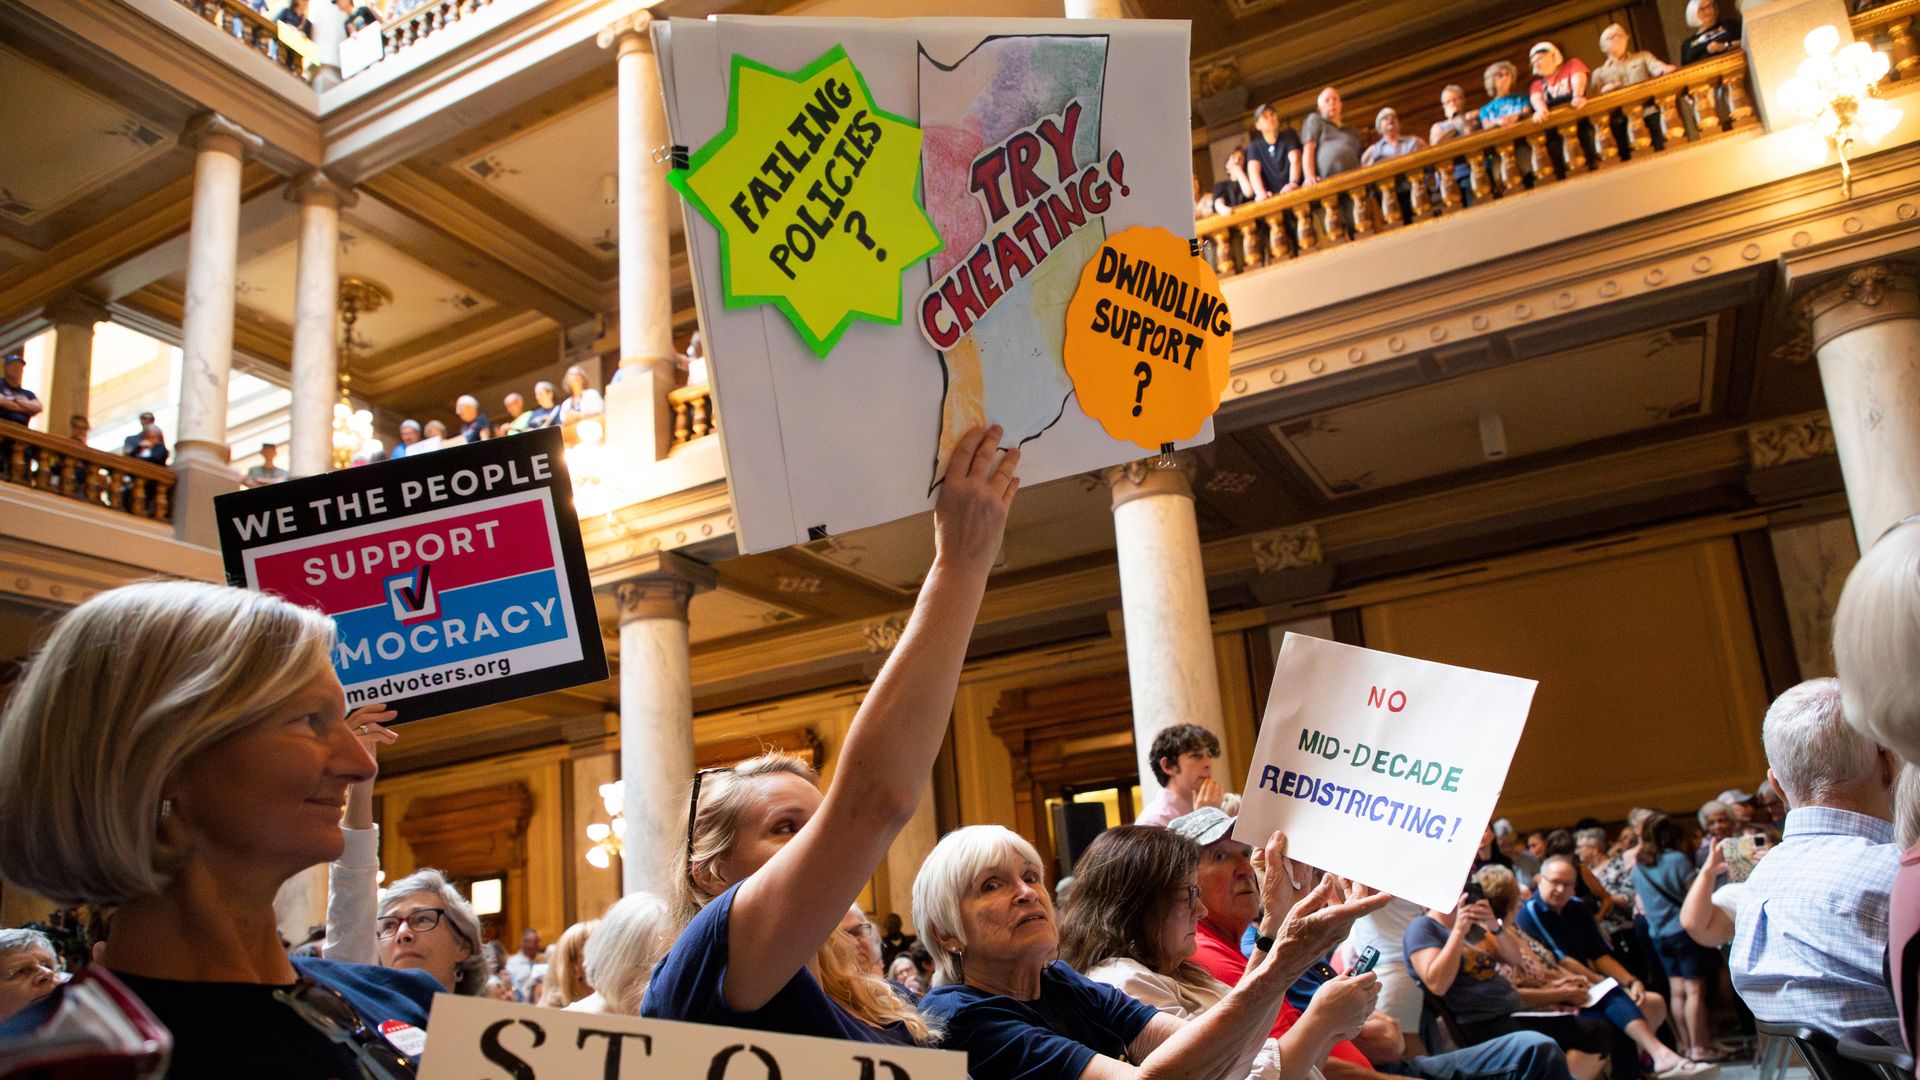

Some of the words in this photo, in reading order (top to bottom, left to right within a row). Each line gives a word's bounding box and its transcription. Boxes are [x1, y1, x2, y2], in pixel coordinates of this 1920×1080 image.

[729, 77, 852, 234] FAILING
[971, 101, 1082, 224] TRY
[769, 109, 882, 281] POLICIES
[843, 210, 887, 262] ?
[922, 149, 1130, 349] CHEATING!
[1095, 246, 1231, 337] DWINDLING
[1091, 298, 1204, 371] SUPPORT
[1131, 361, 1152, 417] ?
[232, 506, 298, 542] WE
[309, 487, 388, 526] THE
[403, 453, 553, 508] PEOPLE
[303, 520, 500, 586] SUPPORT
[338, 597, 556, 671] MOCRACY
[346, 656, 511, 704] madvoters.org
[1367, 686, 1407, 713] NO
[1298, 728, 1464, 793] MID-DECADE
[1259, 764, 1463, 844] REDISTRICTING!
